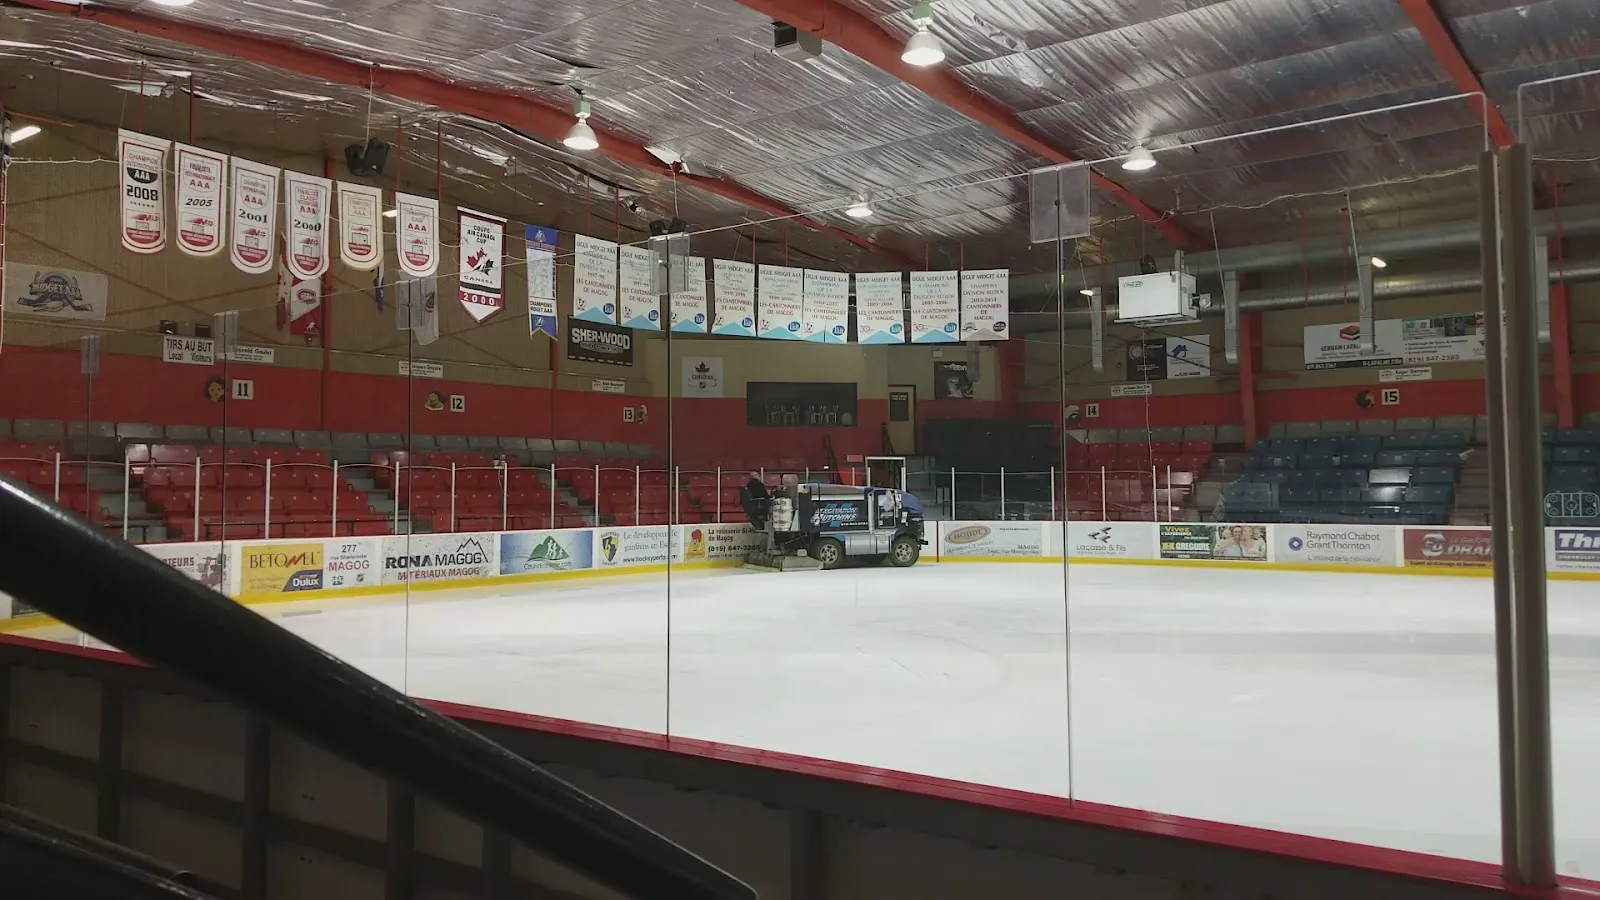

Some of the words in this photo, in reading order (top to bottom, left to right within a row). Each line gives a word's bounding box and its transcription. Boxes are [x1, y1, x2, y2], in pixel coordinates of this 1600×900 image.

[134, 170, 150, 181] AAA
[190, 180, 211, 190] AAA
[127, 184, 158, 201] 2008
[185, 198, 213, 207] 2005
[244, 194, 263, 206] AAA
[300, 206, 316, 215] AAA
[239, 209, 268, 224] 2001
[294, 219, 322, 232] 2000
[408, 223, 427, 232] AAA
[467, 229, 476, 237] AIR
[477, 231, 496, 241] CANADA
[464, 275, 494, 285] CANADA
[585, 280, 616, 291] CANTONNIERS
[591, 289, 609, 297] MAGOG
[464, 293, 495, 306] 2000
[636, 296, 653, 304] MAGOG
[572, 328, 630, 350] SHER-WOOD
[166, 339, 183, 350] TIRS
[185, 341, 196, 351] AU
[198, 342, 213, 353] BUT
[1321, 344, 1343, 352] GERMAIN
[169, 351, 183, 361] Local
[238, 383, 249, 397] 11
[1384, 392, 1398, 403] 15
[452, 398, 463, 410] 12
[624, 409, 633, 420] 13
[1088, 406, 1097, 416] 14
[624, 532, 631, 540] Le
[1307, 531, 1347, 541] Raymond
[1348, 532, 1380, 541] Chabot
[342, 545, 357, 553] 277
[625, 542, 650, 552] gardiens
[1307, 541, 1331, 549] Grant
[1331, 541, 1371, 550] Thornton
[328, 560, 370, 572] MAGOG
[386, 555, 433, 569] RONA
[435, 553, 482, 566] MAGOG
[449, 567, 480, 577] MAGOG
[293, 578, 319, 587] Dulux
